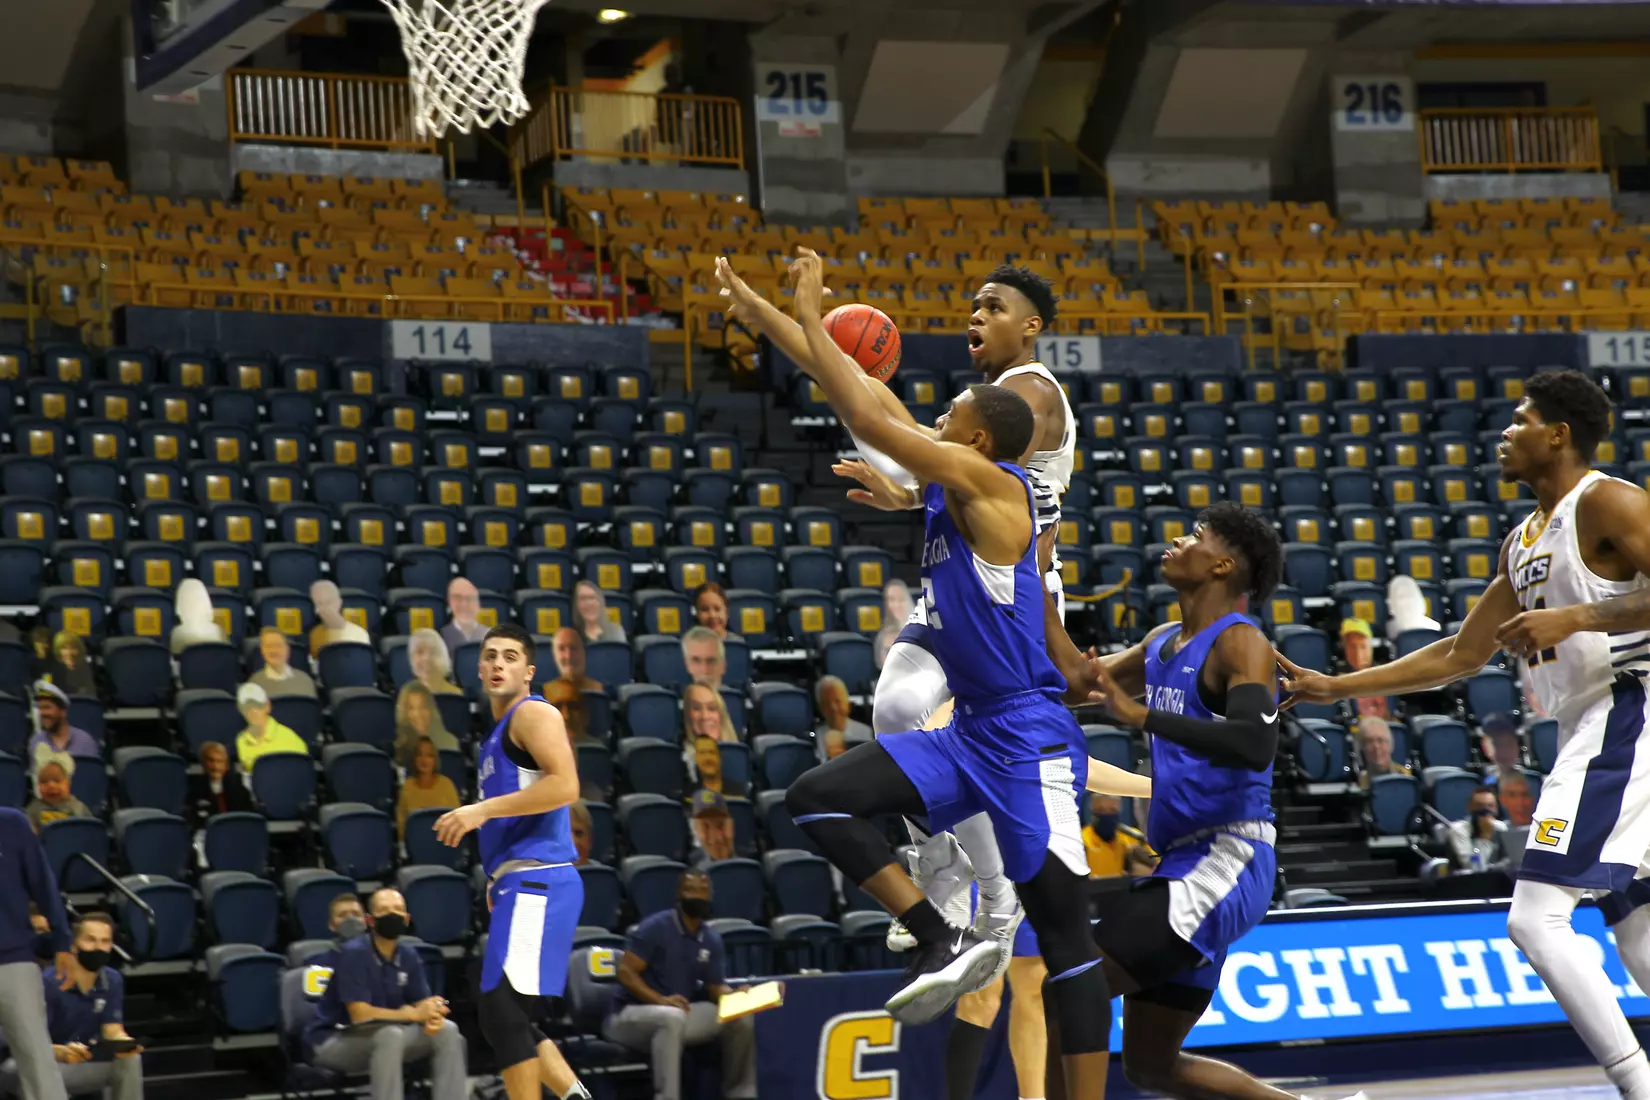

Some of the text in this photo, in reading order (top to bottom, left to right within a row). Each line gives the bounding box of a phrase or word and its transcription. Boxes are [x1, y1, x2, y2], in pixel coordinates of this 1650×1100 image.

[765, 70, 828, 116] 215
[1344, 82, 1404, 125] 216
[412, 325, 473, 355] 114
[1535, 818, 1568, 847] C
[1194, 943, 1412, 1026] GHT
[816, 1009, 902, 1100] C
